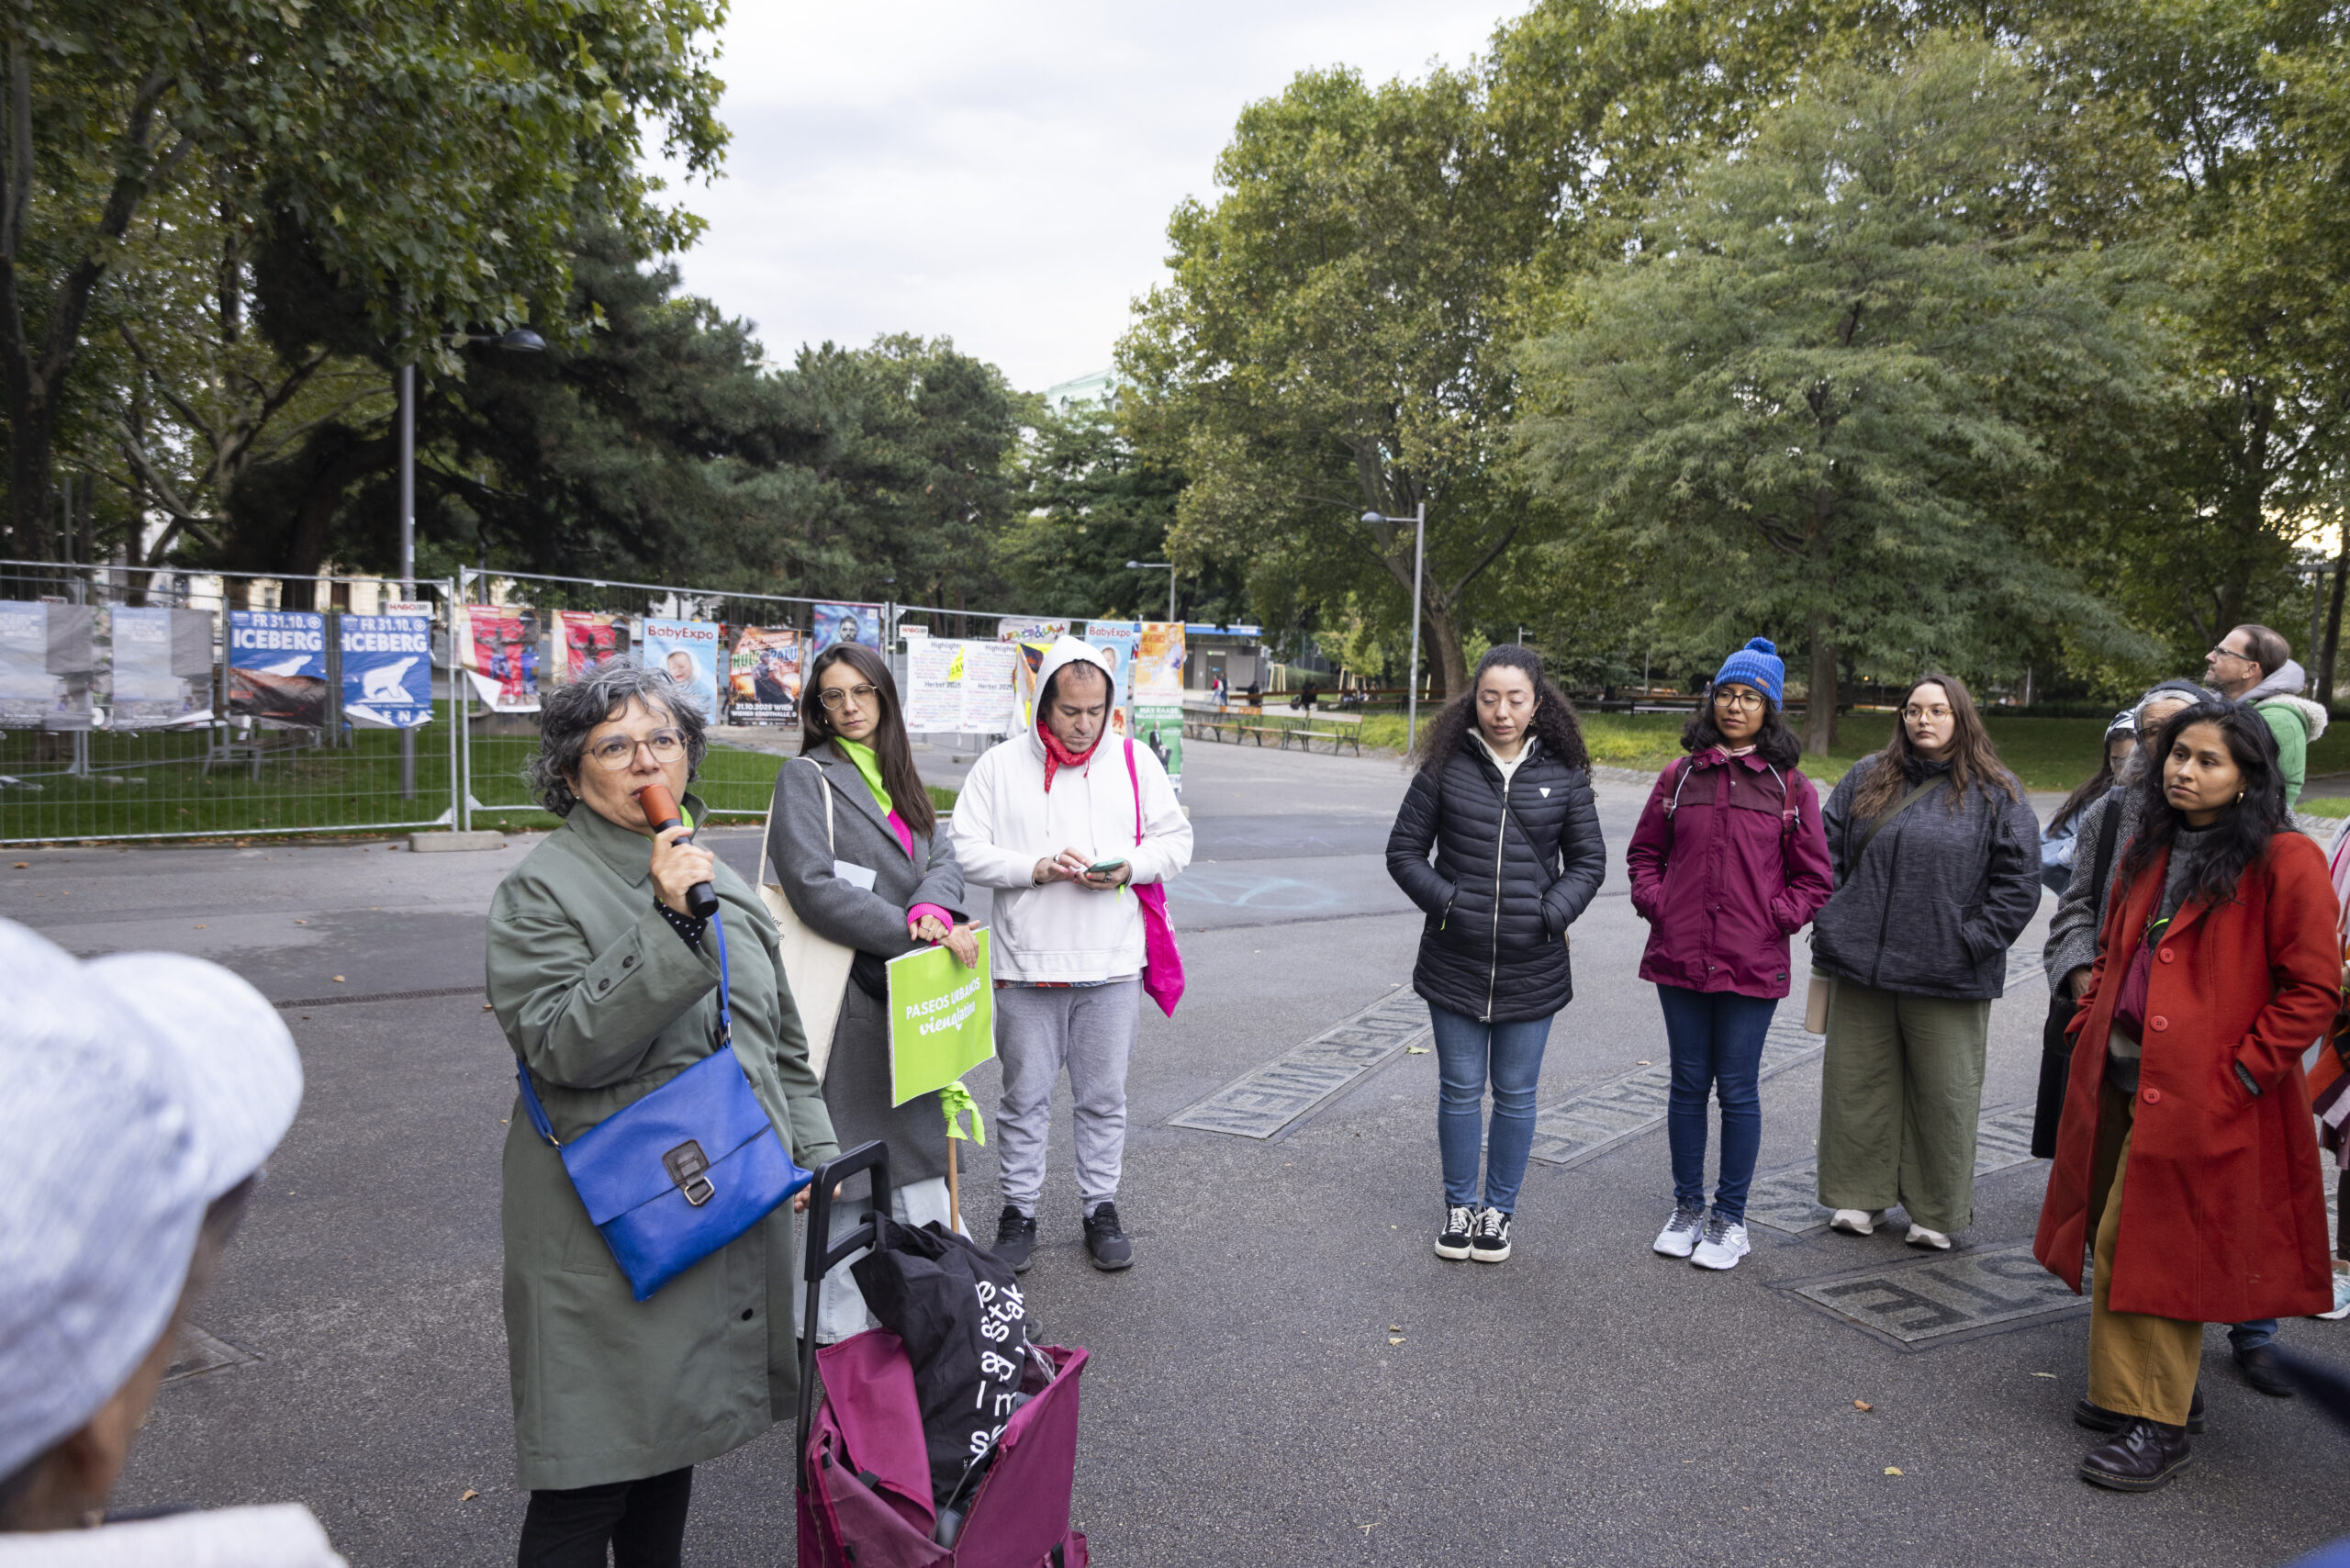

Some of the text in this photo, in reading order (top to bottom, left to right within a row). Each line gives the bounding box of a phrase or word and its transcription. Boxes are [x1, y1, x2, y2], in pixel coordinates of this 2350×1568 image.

[252, 613, 268, 627] FR
[270, 614, 307, 629] 31.10.
[360, 618, 376, 632] FR
[378, 618, 412, 632] 31.10.
[233, 629, 323, 651] ICEBERG
[648, 625, 714, 642] BabyExpo
[1089, 626, 1131, 639] BabyExpo
[342, 633, 428, 653] ICEBERG
[985, 644, 1017, 653] Highlights
[735, 702, 794, 711] 31.10.2025 WIEN
[906, 977, 980, 1020] PASEOS URBANOS
